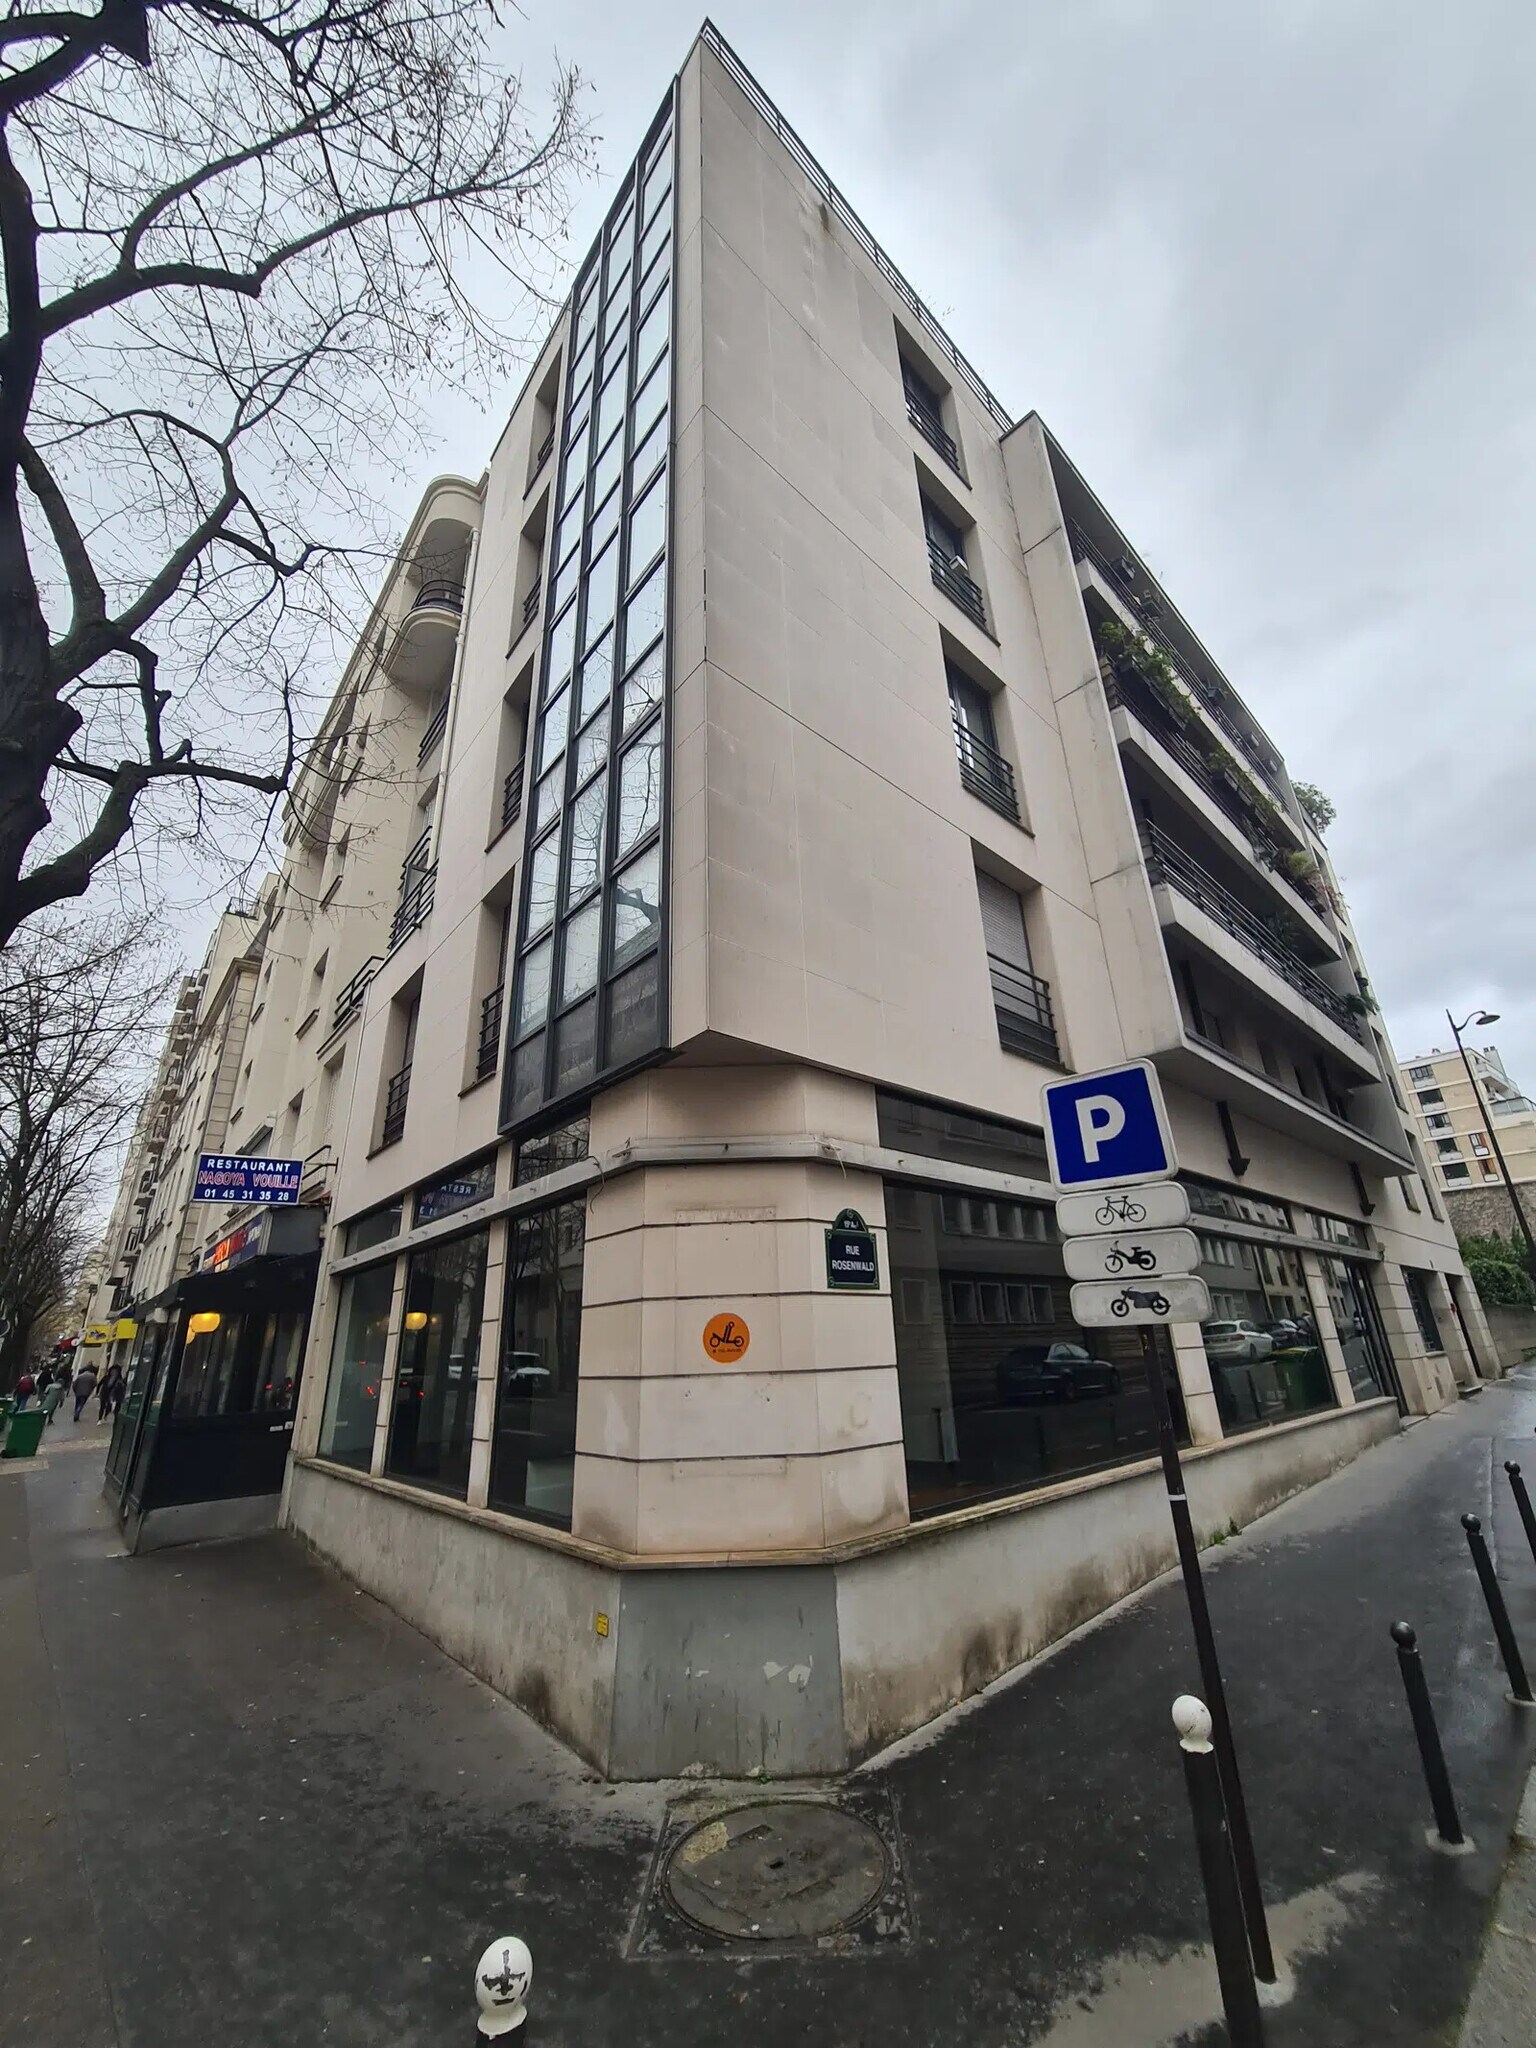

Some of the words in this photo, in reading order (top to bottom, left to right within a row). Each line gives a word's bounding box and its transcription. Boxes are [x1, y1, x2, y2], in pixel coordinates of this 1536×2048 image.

[1075, 1094, 1126, 1164] P
[207, 1159, 291, 1173] RESTAURANT
[197, 1171, 245, 1186] NAGOYA
[253, 1174, 299, 1189] VOUILLE
[204, 1189, 216, 1198] 01
[222, 1190, 235, 1199] 45
[242, 1190, 253, 1200] 31
[259, 1191, 272, 1200] 35
[277, 1191, 289, 1201] 28
[845, 1245, 860, 1256] RUE
[832, 1259, 875, 1272] ROSENWALD
